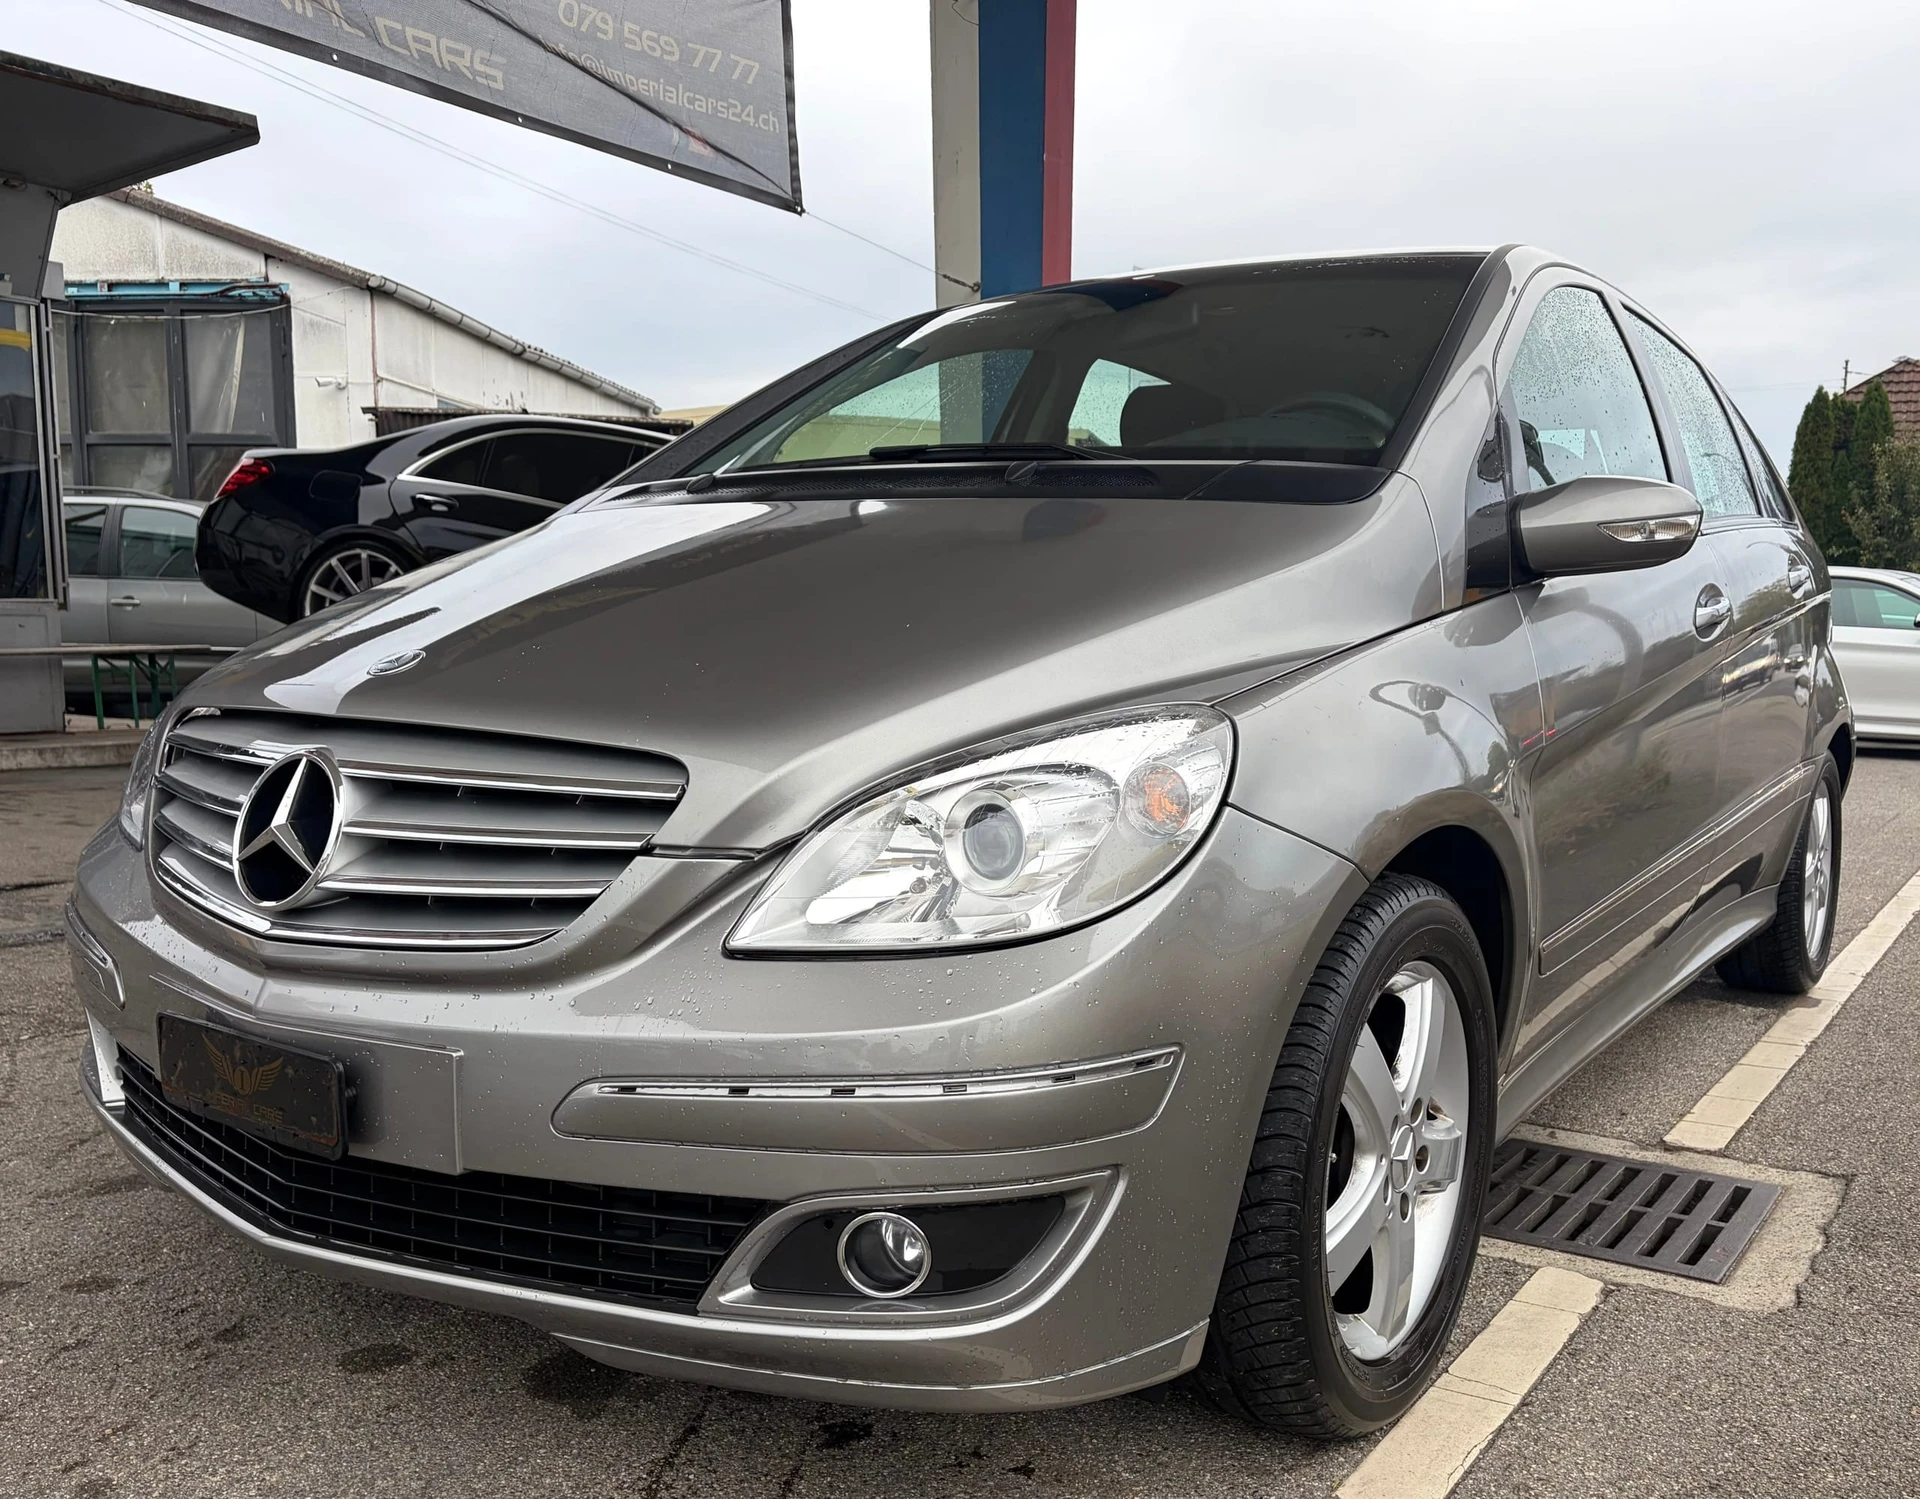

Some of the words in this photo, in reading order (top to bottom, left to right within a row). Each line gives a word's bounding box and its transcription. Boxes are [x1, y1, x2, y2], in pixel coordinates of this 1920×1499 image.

[374, 16, 506, 91] CARS
[557, 0, 614, 41] 079
[623, 20, 680, 62] 569
[687, 42, 723, 73] 77
[730, 53, 760, 85] 77
